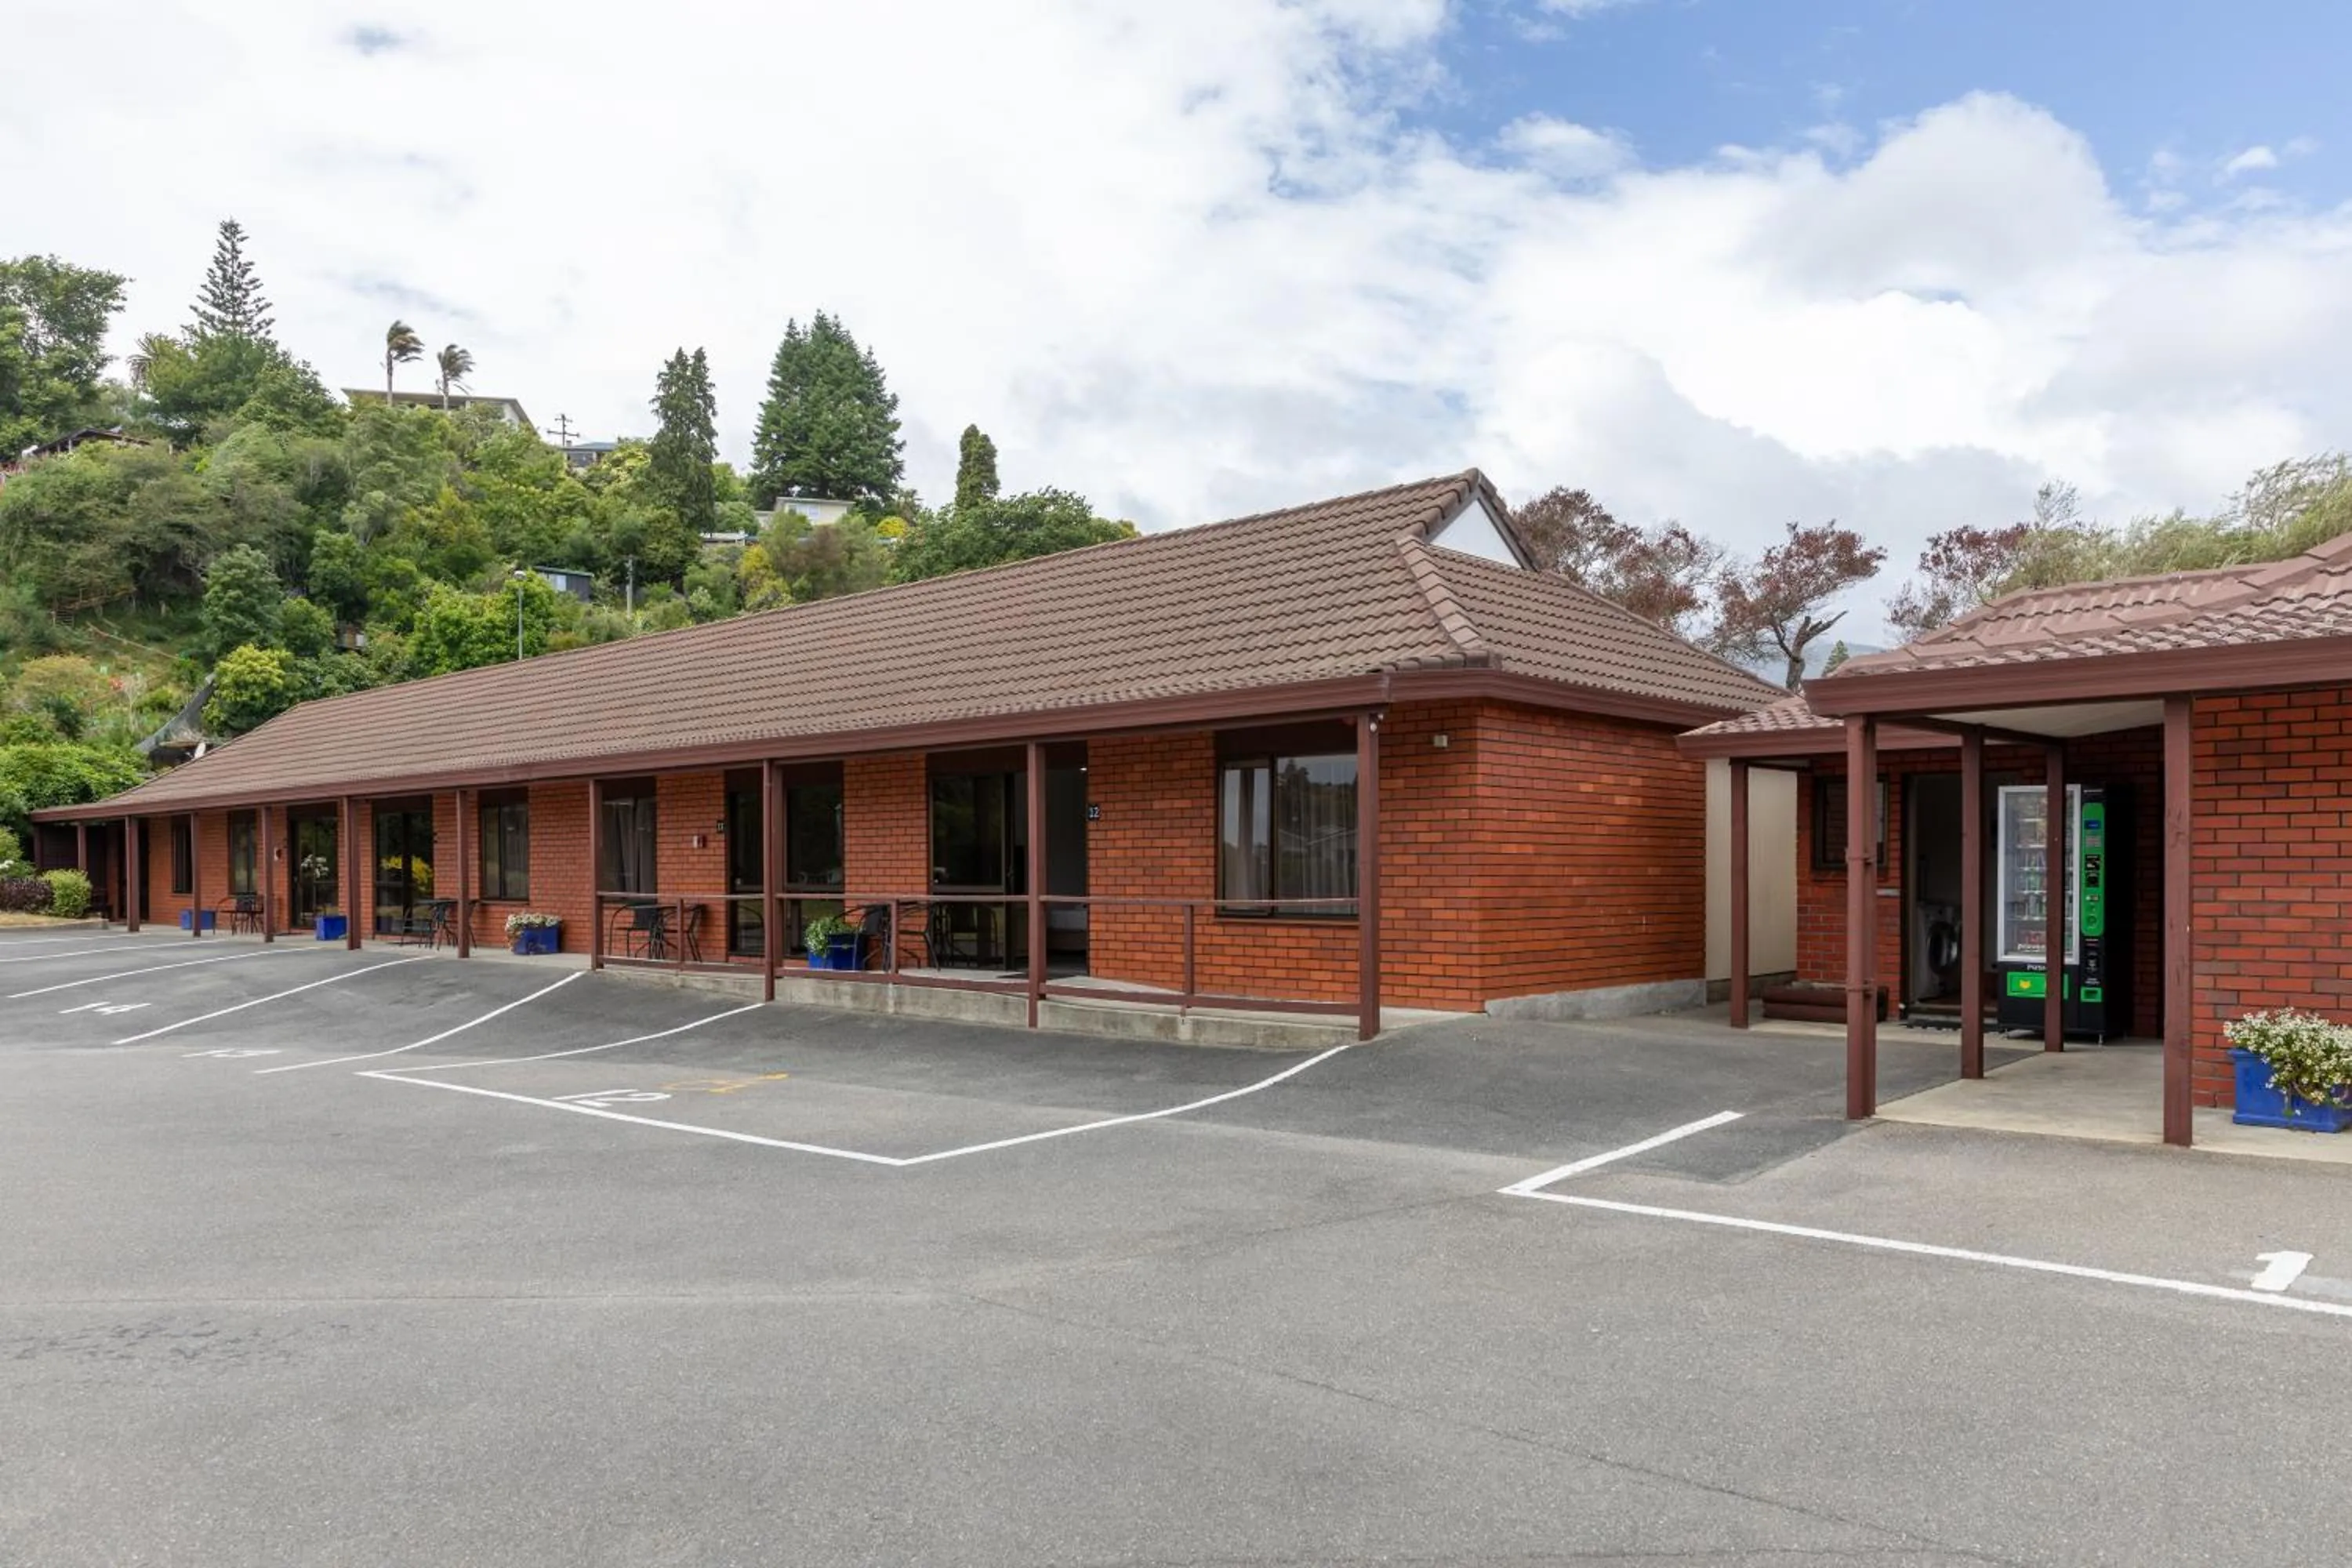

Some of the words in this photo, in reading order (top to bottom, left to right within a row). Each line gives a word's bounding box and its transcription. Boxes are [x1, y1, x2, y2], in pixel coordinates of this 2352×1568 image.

[1089, 807, 1100, 818] 12
[551, 1088, 672, 1108] 12
[2251, 1250, 2314, 1291] 1
